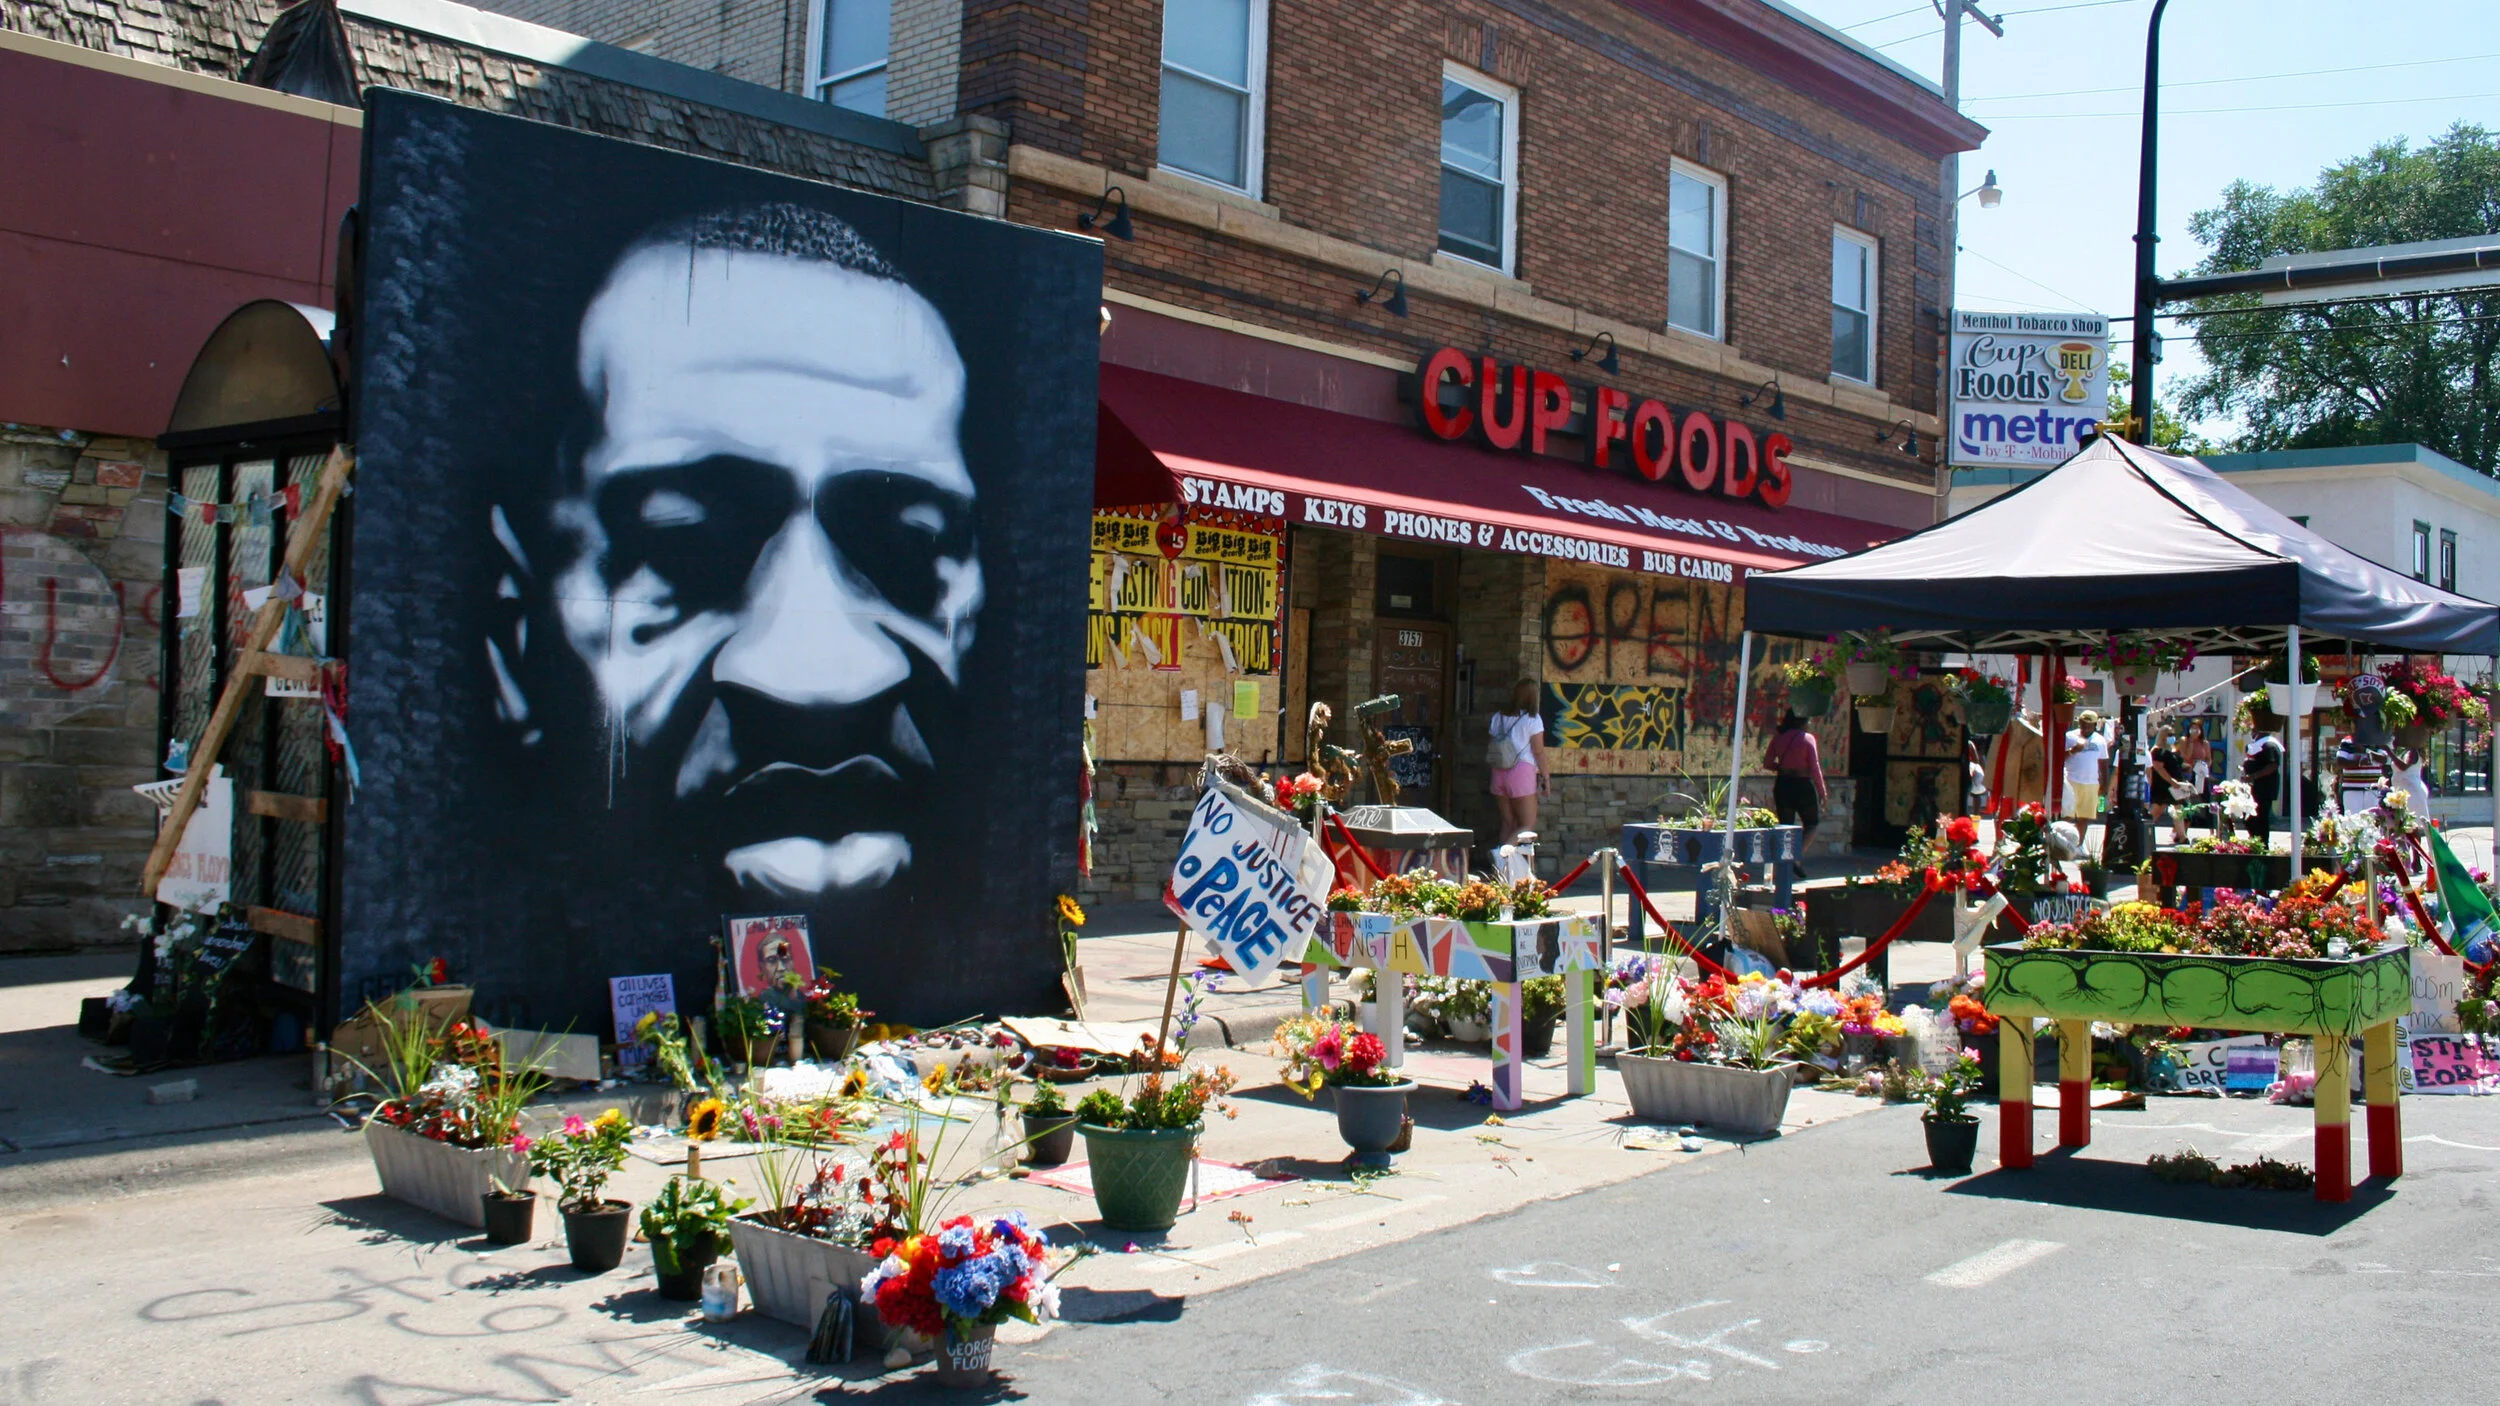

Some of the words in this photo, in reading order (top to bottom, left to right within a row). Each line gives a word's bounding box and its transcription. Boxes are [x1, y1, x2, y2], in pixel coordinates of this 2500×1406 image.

[1962, 315, 2012, 330] Menthol
[2016, 316, 2068, 332] Tobacco
[2071, 318, 2102, 335] Shop
[1967, 335, 2046, 375] Cup
[2060, 353, 2092, 371] DELI
[1958, 368, 2051, 400] Foods
[1422, 346, 1572, 455] CUP
[1594, 385, 1793, 509] FOODS
[1963, 408, 2098, 446] metro
[1985, 445, 2002, 461] by
[1521, 484, 1639, 525] Fresh
[1623, 504, 1716, 539] Meat
[1094, 520, 1121, 542] Big
[1123, 523, 1150, 544] Big
[1182, 477, 1285, 517] STAMPS
[1303, 497, 1367, 530] KEYS
[1384, 509, 1473, 545] PHONES
[1476, 523, 1495, 547] &
[1500, 529, 1630, 569] ACCESSORIES
[1642, 552, 1677, 575] BUS
[1679, 558, 1734, 584] CARDS
[1195, 530, 1221, 550] Big
[1222, 535, 1246, 554] Big
[1248, 538, 1272, 555] Big
[1399, 631, 1422, 647] 3757
[1546, 580, 1732, 678] OPEN
[1197, 792, 1234, 836] NO
[1175, 828, 1202, 879] O
[1231, 839, 1321, 934] JUSTICE
[2033, 899, 2050, 921] NO
[2051, 896, 2091, 922] JUSTICE
[1364, 918, 1373, 930] IS
[2186, 1069, 2228, 1087] BRE
[946, 1336, 993, 1358] GEORGE
